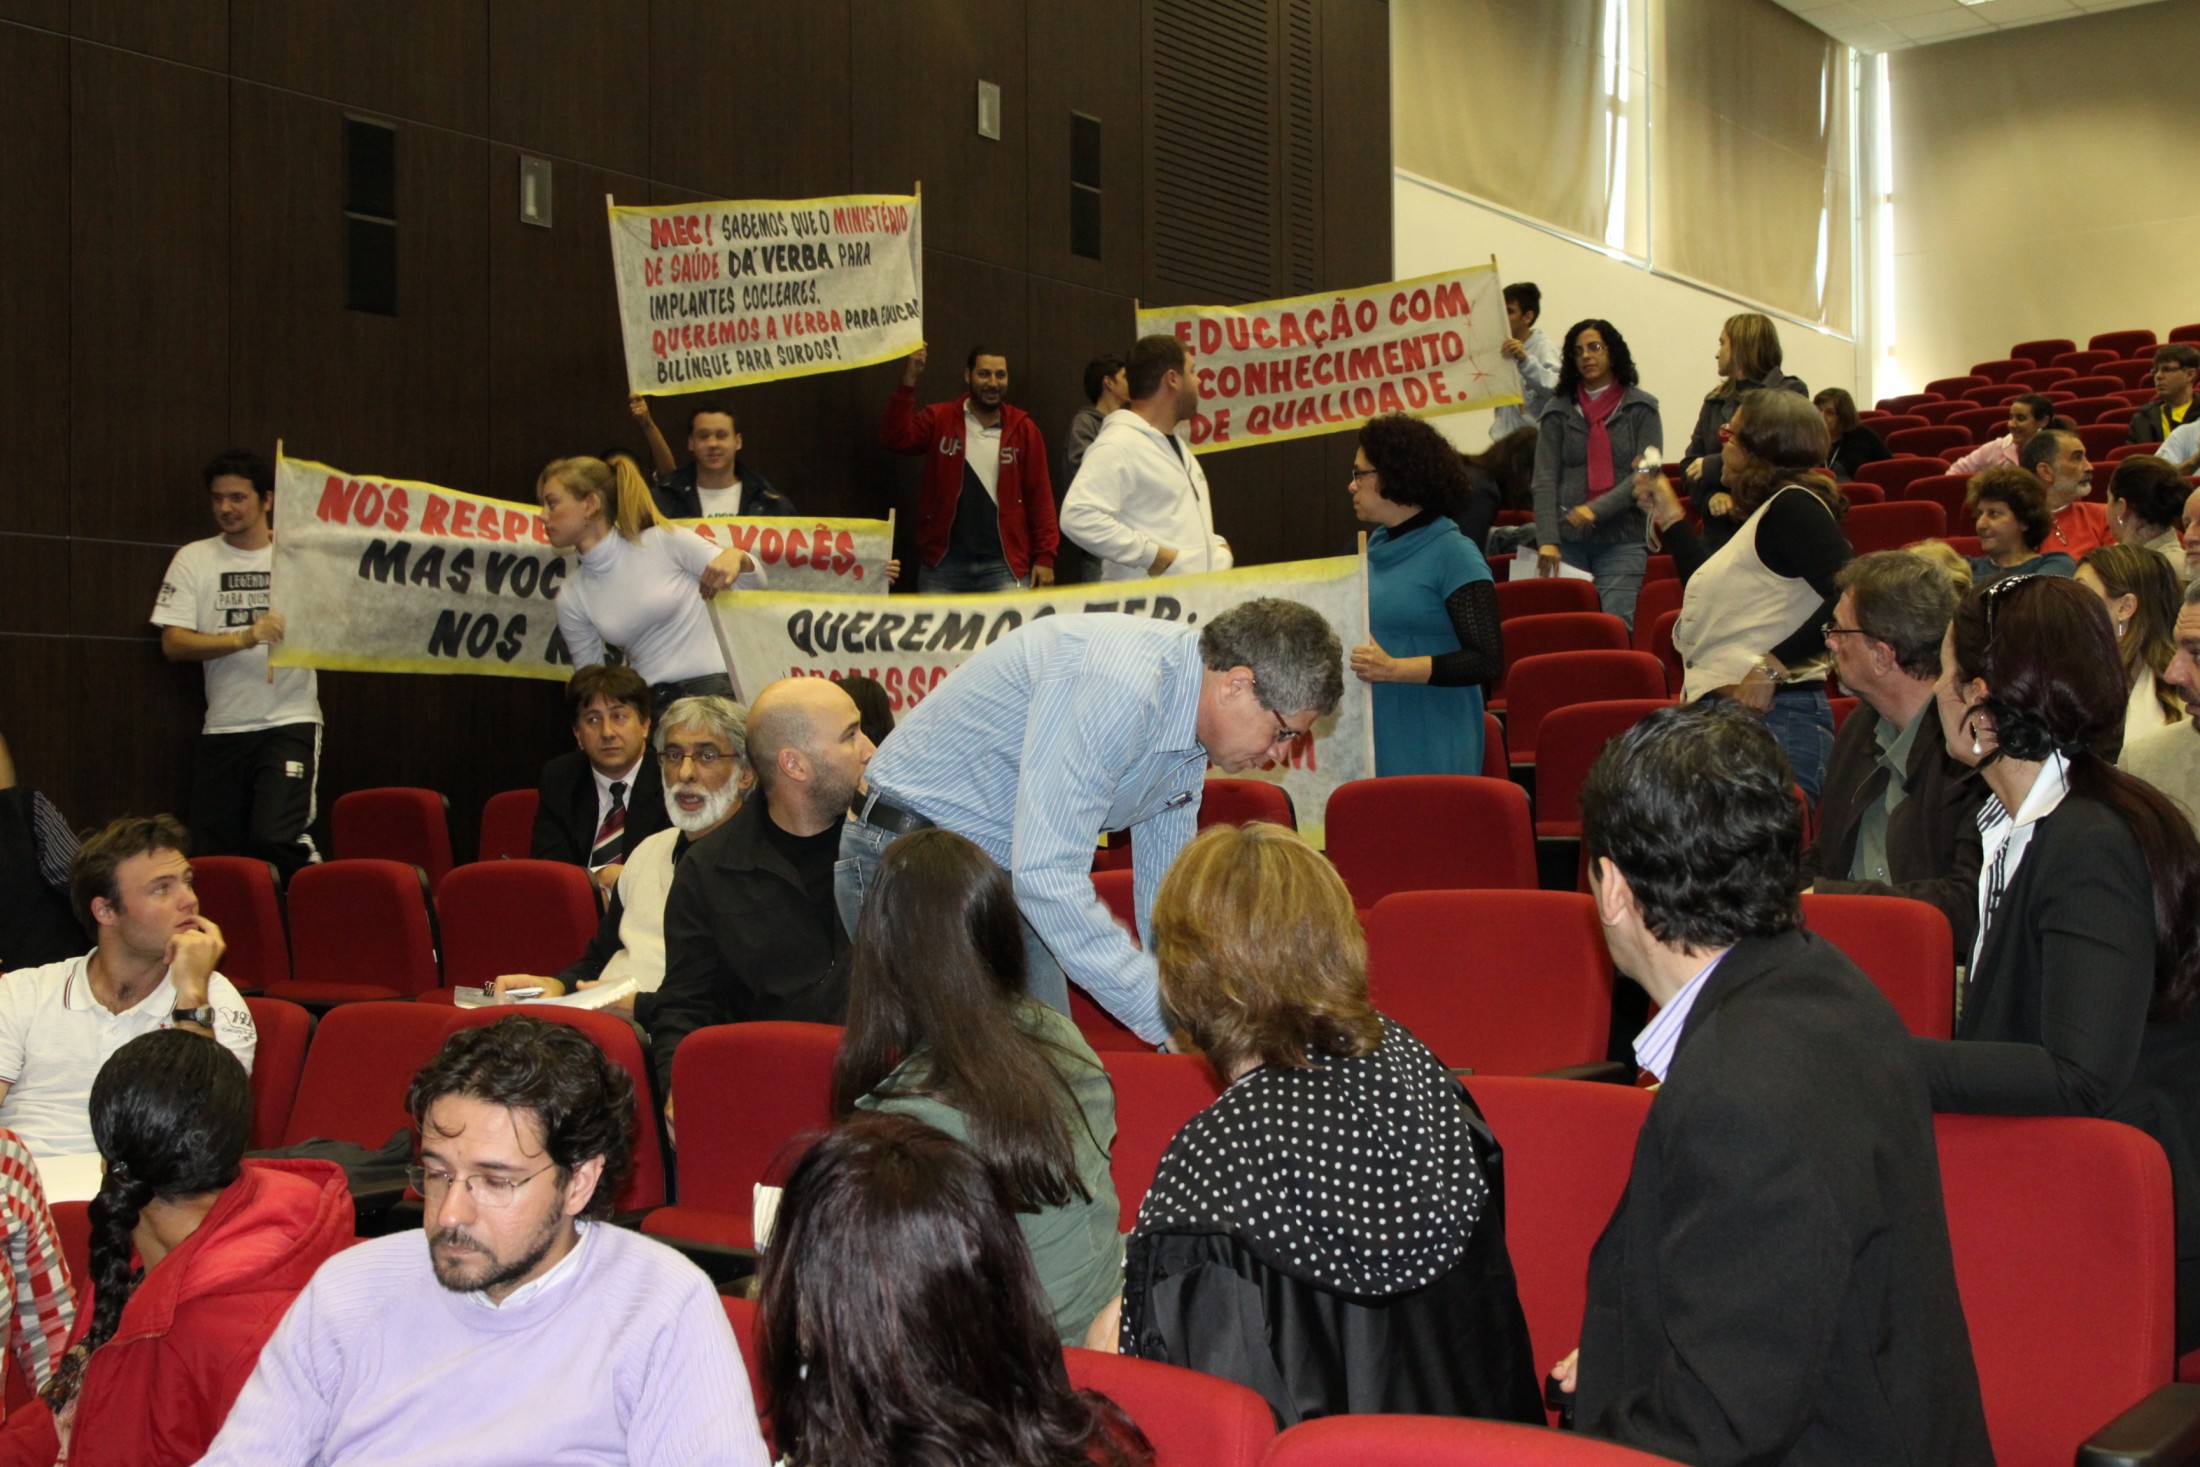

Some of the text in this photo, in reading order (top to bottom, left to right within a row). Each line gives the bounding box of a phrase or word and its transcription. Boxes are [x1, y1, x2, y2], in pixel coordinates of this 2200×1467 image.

[651, 213, 713, 250] MEC!
[722, 209, 788, 242] SABEMOS
[791, 209, 818, 239] QUE
[819, 209, 830, 235] O
[644, 256, 663, 287] DE
[671, 247, 719, 283] SAÚDE
[762, 243, 834, 273] VERBA
[838, 241, 871, 267] PARA
[650, 278, 820, 321] IMPLANTES COCLEARES.
[1174, 281, 1470, 355] EDUCAÇÃO COM
[652, 298, 919, 360] QUEREMOS A VERBA PARA EDUCA
[657, 336, 840, 383] BILÍNGUE PARA SURDOS!
[1196, 331, 1465, 400] CONHECIMENTO
[1189, 371, 1467, 445] DE QUALIDADE.
[316, 475, 864, 581] NÓS RESPE VOCÊS,
[358, 539, 566, 600] MAS VOC
[219, 592, 243, 606] PARA
[427, 609, 528, 663] NOS
[787, 606, 1056, 657] QUEREMO
